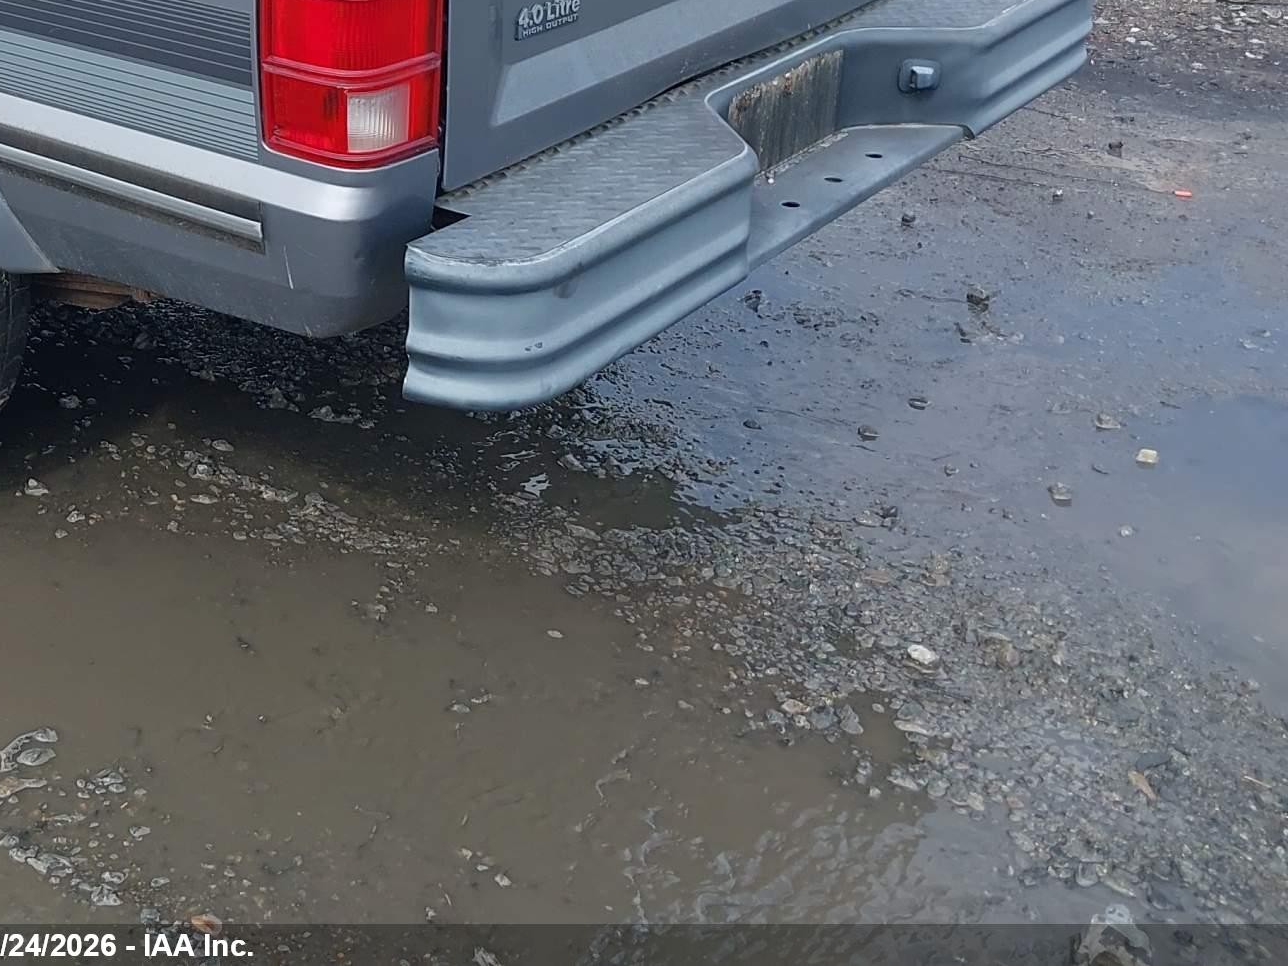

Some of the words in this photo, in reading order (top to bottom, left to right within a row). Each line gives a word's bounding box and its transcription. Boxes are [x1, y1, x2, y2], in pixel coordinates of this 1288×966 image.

[518, 3, 544, 28] 4.0
[522, 25, 544, 38] HIGH
[546, 13, 579, 30] OUTPUT
